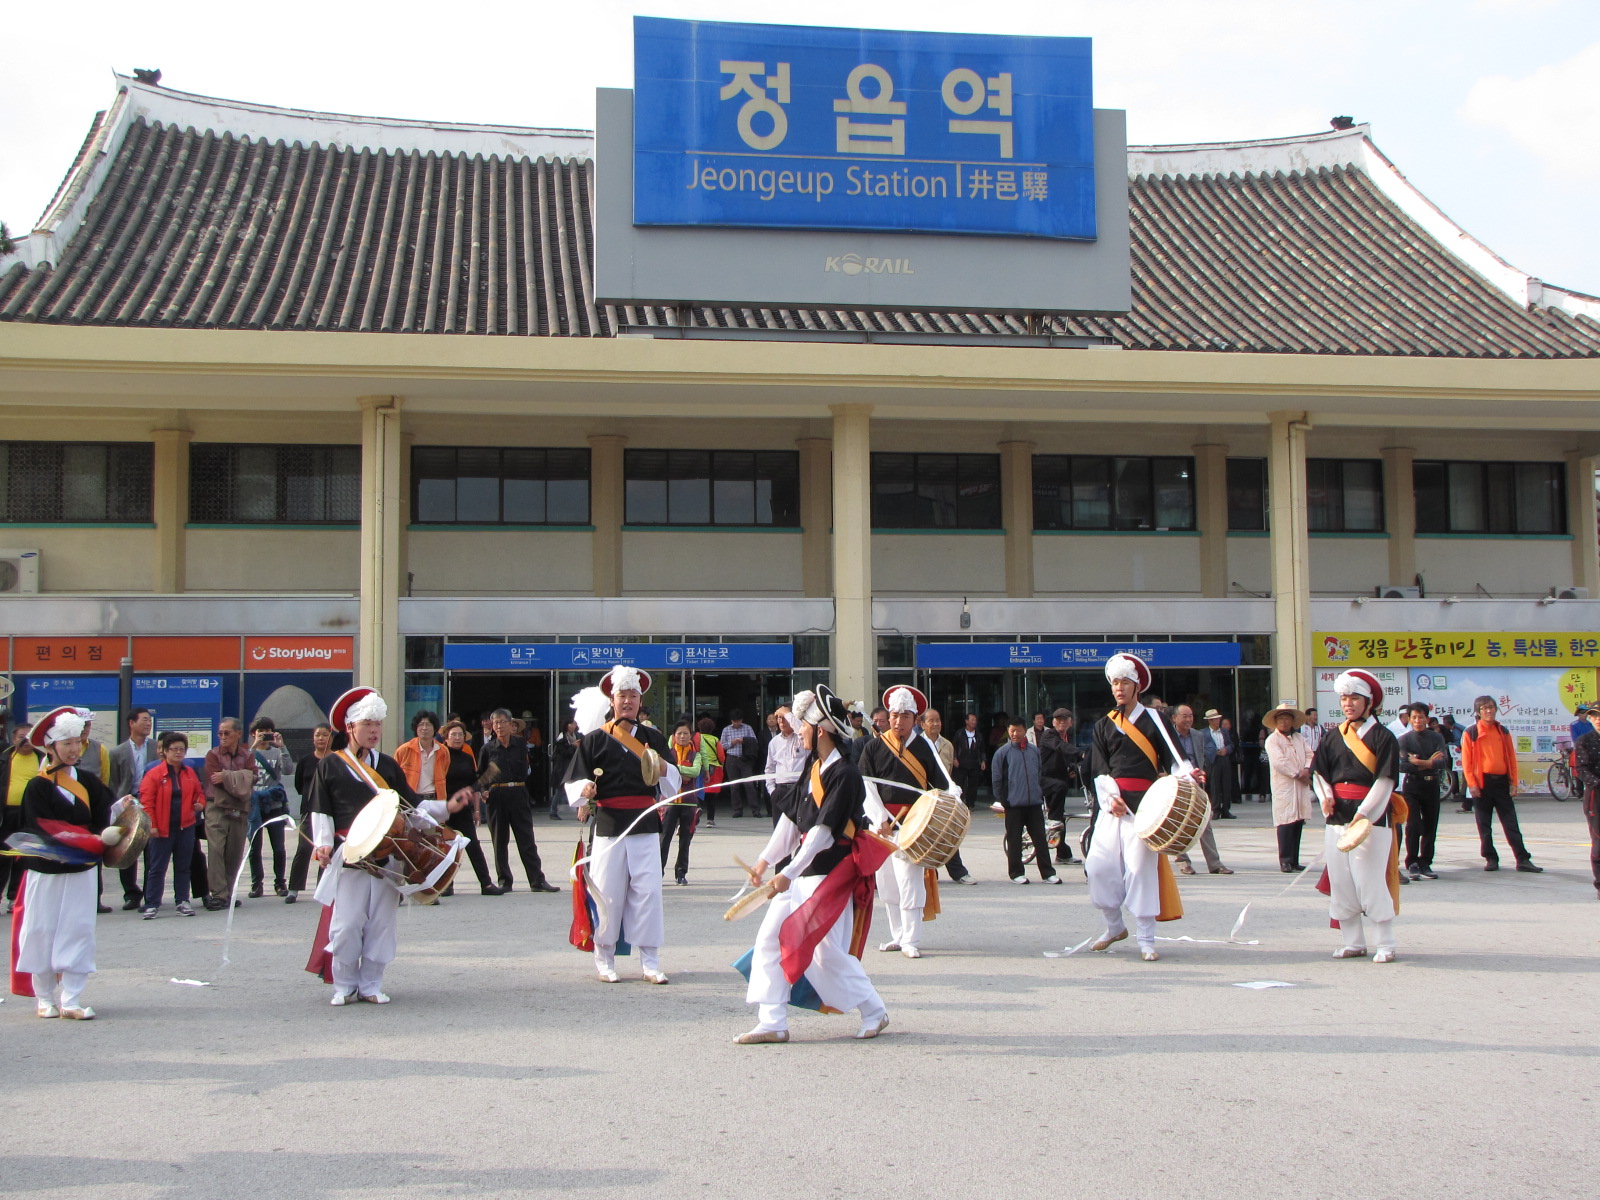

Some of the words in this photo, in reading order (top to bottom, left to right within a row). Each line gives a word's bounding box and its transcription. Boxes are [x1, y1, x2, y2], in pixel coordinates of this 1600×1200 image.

[719, 60, 1013, 159] 정읍역
[686, 159, 834, 202] Jeongeup
[846, 166, 947, 198] Station
[969, 168, 1048, 202] 井邑驛
[824, 253, 915, 275] KORAIL
[35, 645, 102, 661] 편의점
[269, 647, 332, 660] StoryWay
[511, 648, 535, 658] 입구
[591, 647, 625, 658] 맞이방
[686, 647, 729, 657] 표사는곳
[1009, 646, 1029, 655] 입구
[1074, 649, 1098, 657] 맞이방
[1358, 638, 1389, 659] 정읍
[1394, 637, 1476, 659] 단풍미인
[1486, 638, 1507, 658] 농,
[1513, 638, 1563, 658] 특산물,
[1321, 673, 1335, 681] 세계
